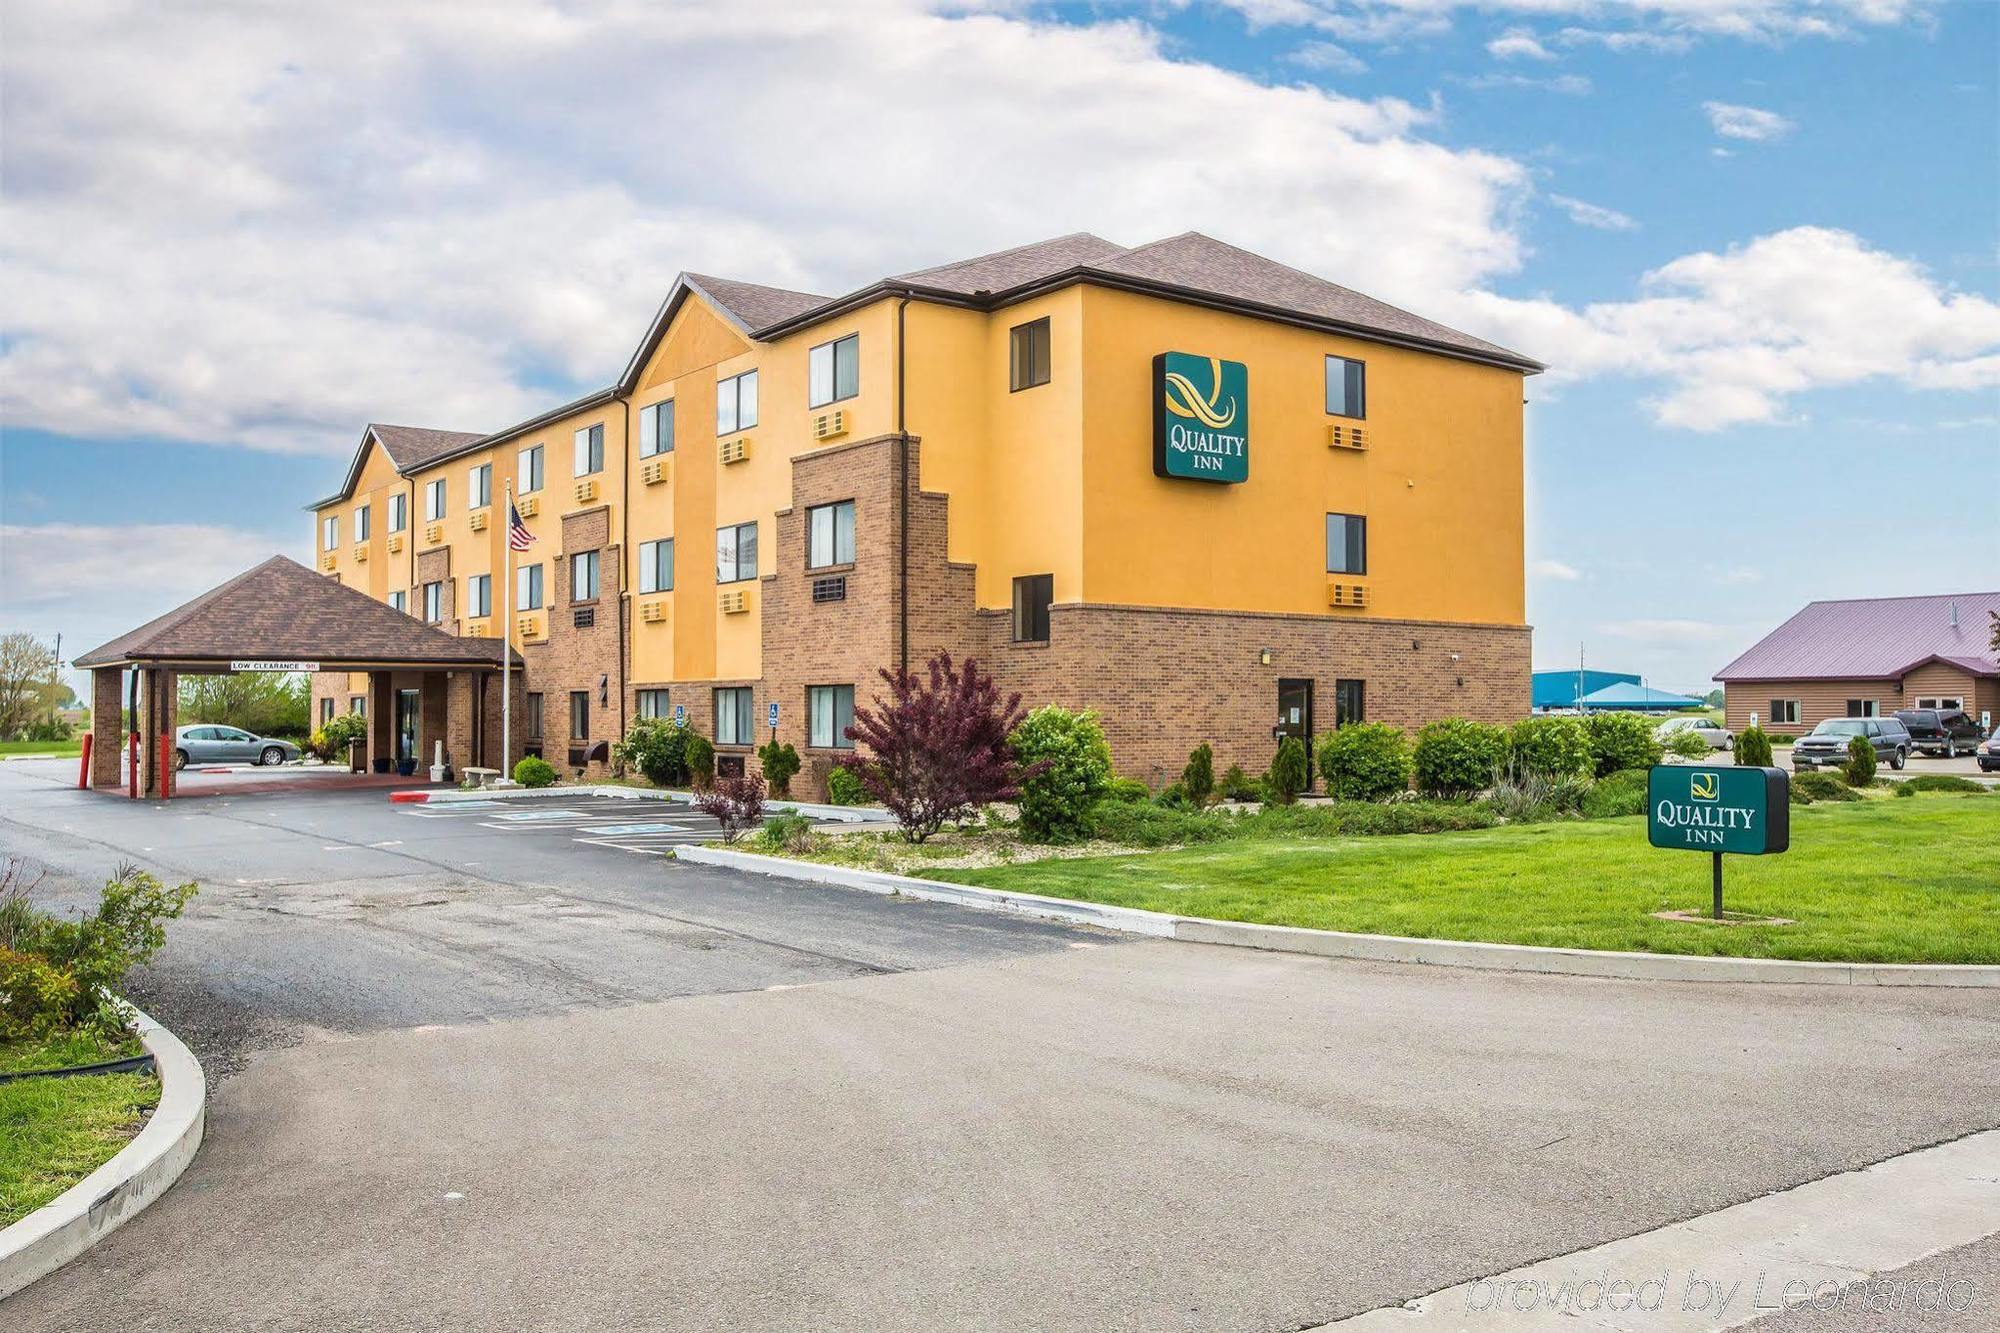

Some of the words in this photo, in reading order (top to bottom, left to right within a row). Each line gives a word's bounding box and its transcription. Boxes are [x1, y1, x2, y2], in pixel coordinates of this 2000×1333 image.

[1170, 424, 1245, 457] QUALITY
[1193, 455, 1223, 471] INN
[232, 662, 251, 670] LOW
[253, 662, 300, 670] CLEARANCE
[1657, 800, 1756, 829] QUALITY
[1685, 828, 1724, 844] INN
